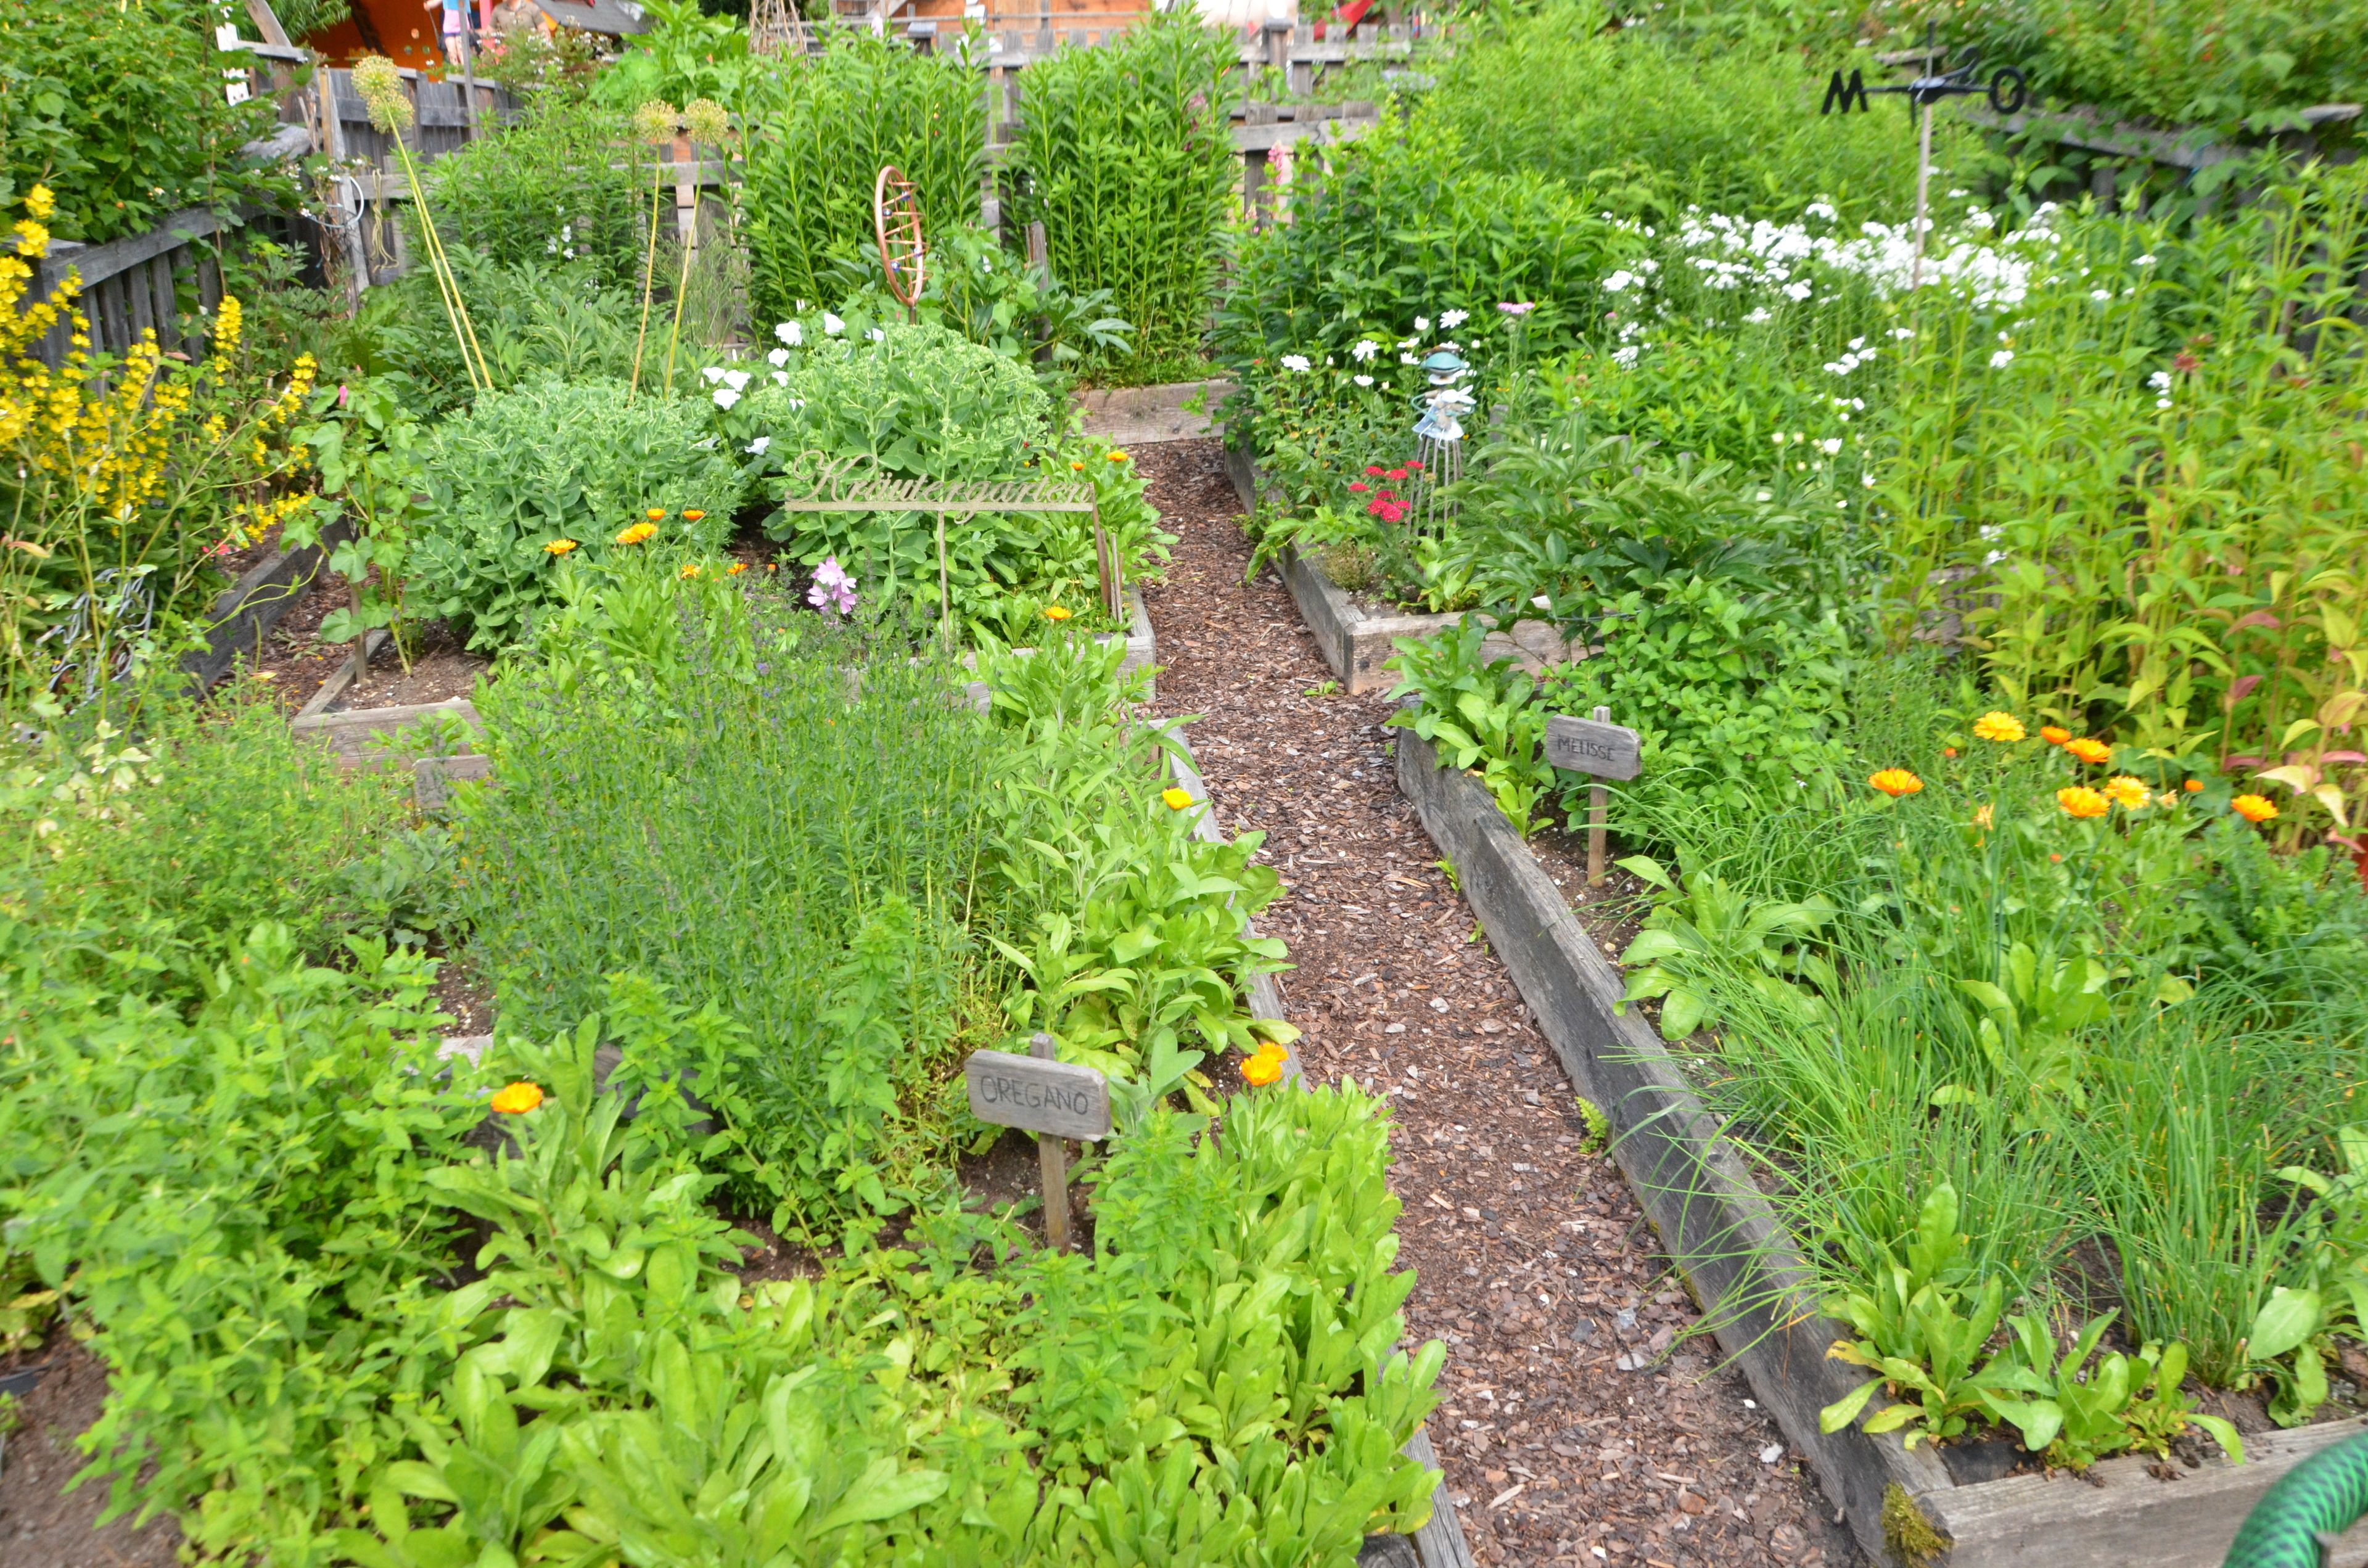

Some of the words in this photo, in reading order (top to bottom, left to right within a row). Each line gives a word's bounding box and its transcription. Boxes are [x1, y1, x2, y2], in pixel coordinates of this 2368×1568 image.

[1989, 66, 2025, 115] O
[784, 449, 1093, 525] Kräutergarten
[1557, 734, 1615, 761] MELISSE
[980, 1075, 1088, 1115] OREGANO
